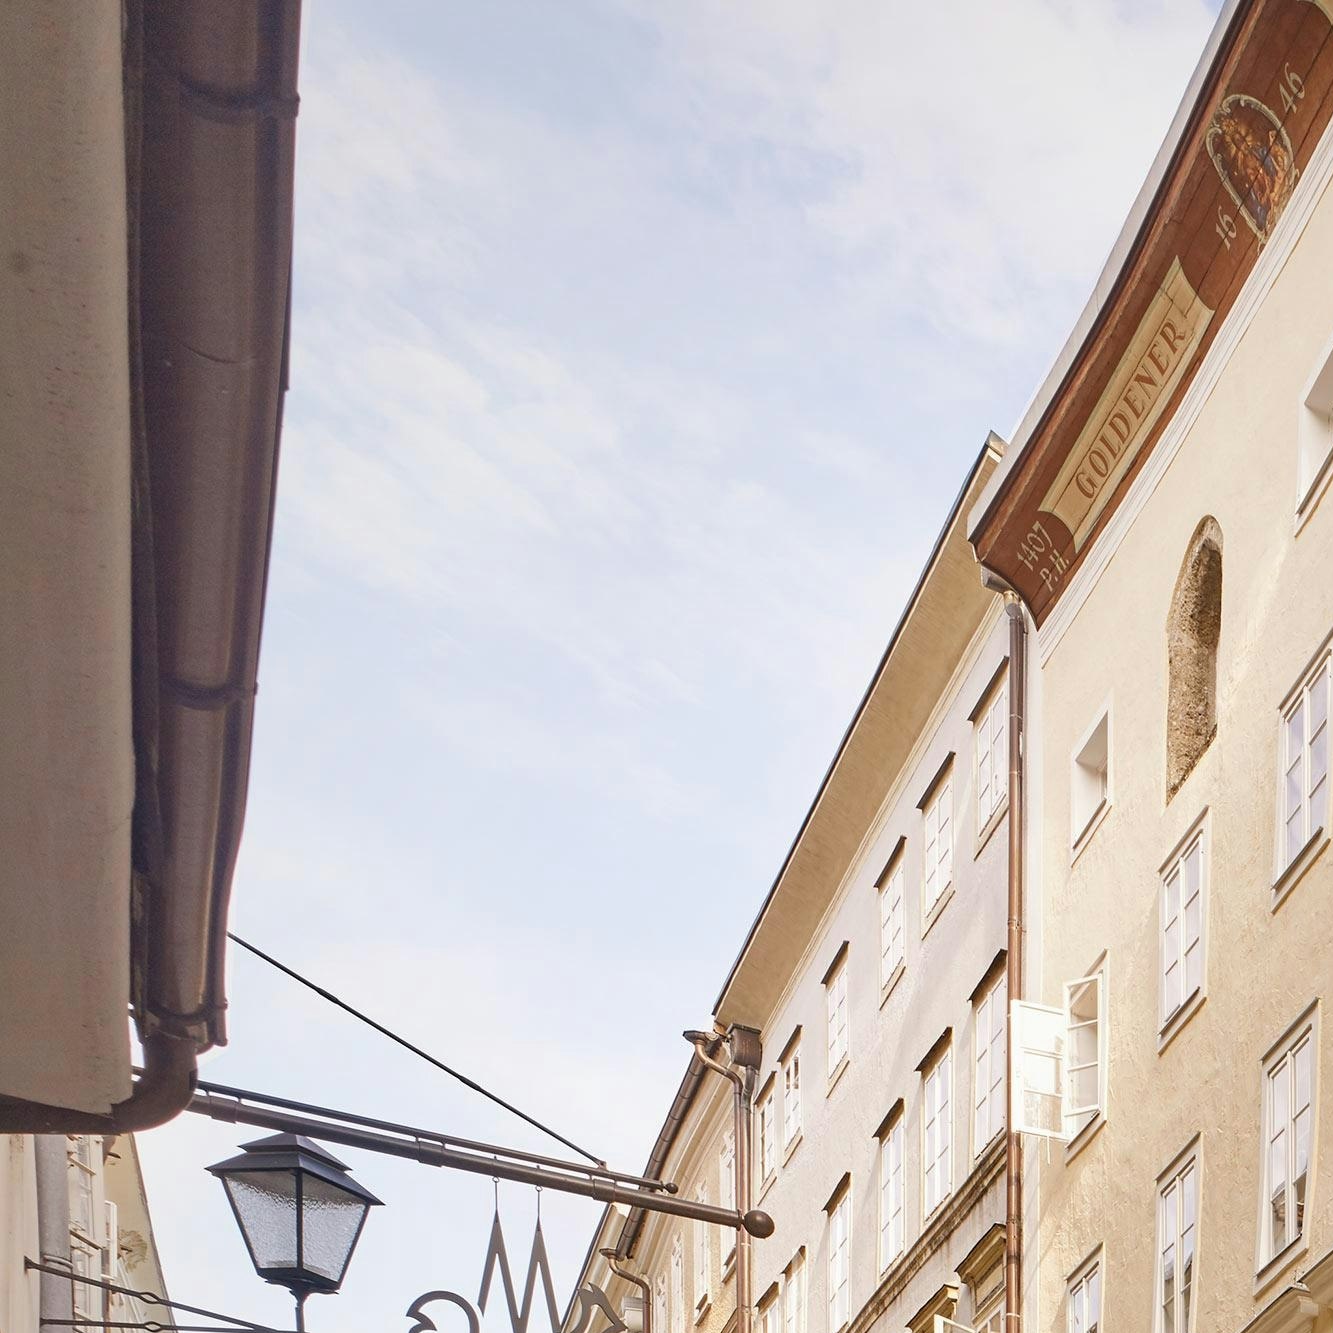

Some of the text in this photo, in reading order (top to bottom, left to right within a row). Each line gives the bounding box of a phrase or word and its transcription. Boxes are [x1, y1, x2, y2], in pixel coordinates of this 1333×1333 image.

[1279, 62, 1306, 114] 46
[1075, 320, 1185, 499] GOLDENER
[1017, 521, 1053, 572] 1407
